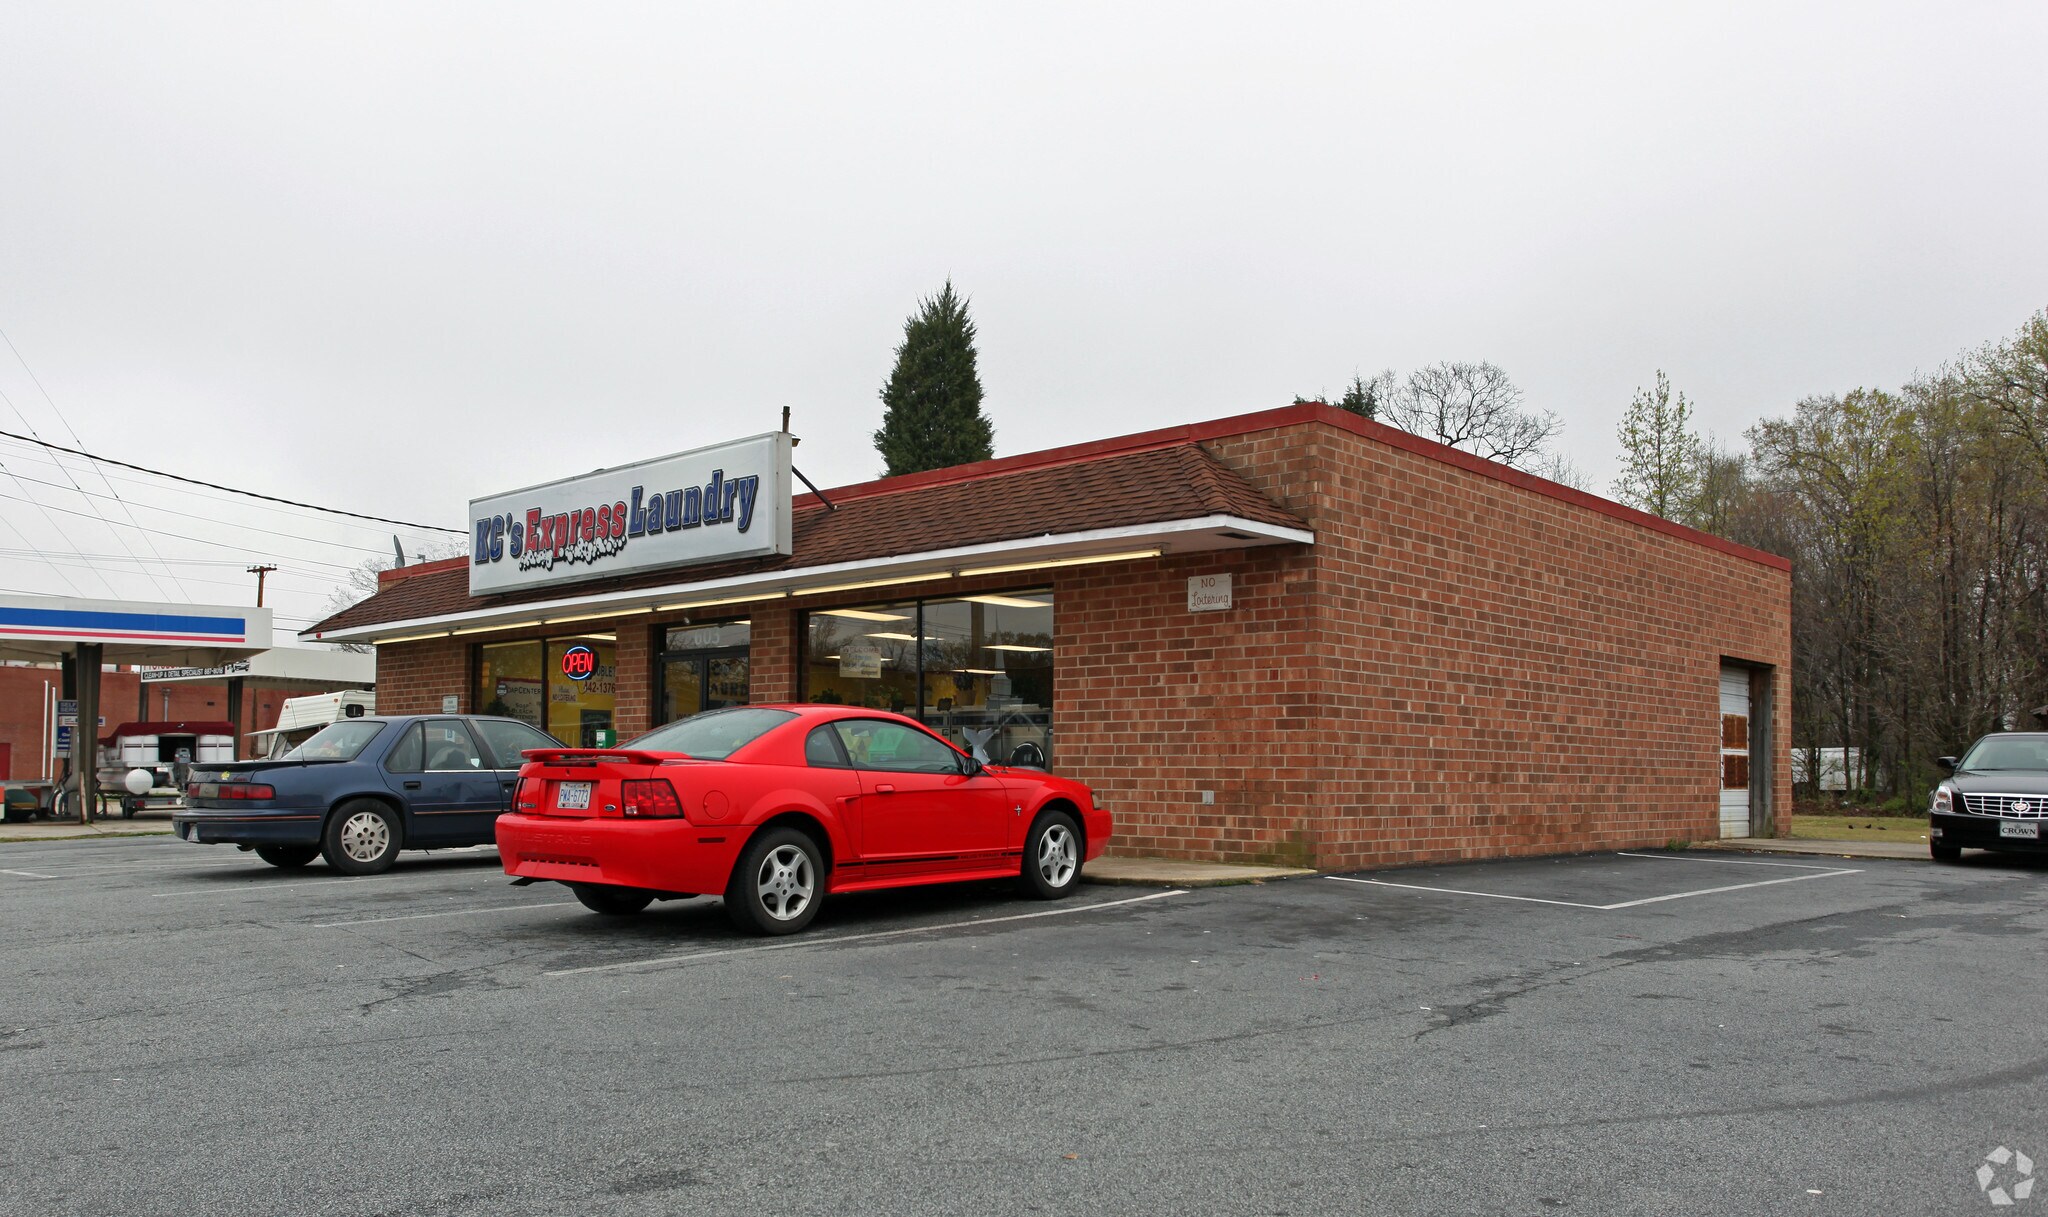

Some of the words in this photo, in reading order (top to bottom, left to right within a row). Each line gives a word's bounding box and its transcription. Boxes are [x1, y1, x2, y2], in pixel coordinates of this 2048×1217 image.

[475, 512, 523, 565] KC's
[525, 501, 627, 560] Express
[628, 469, 758, 538] Laundry
[1201, 577, 1216, 588] NO
[1192, 591, 1229, 608] Loitering
[562, 652, 594, 673] OPEN
[181, 668, 204, 677] SPECIALIST
[2001, 827, 2036, 835] CROWN
